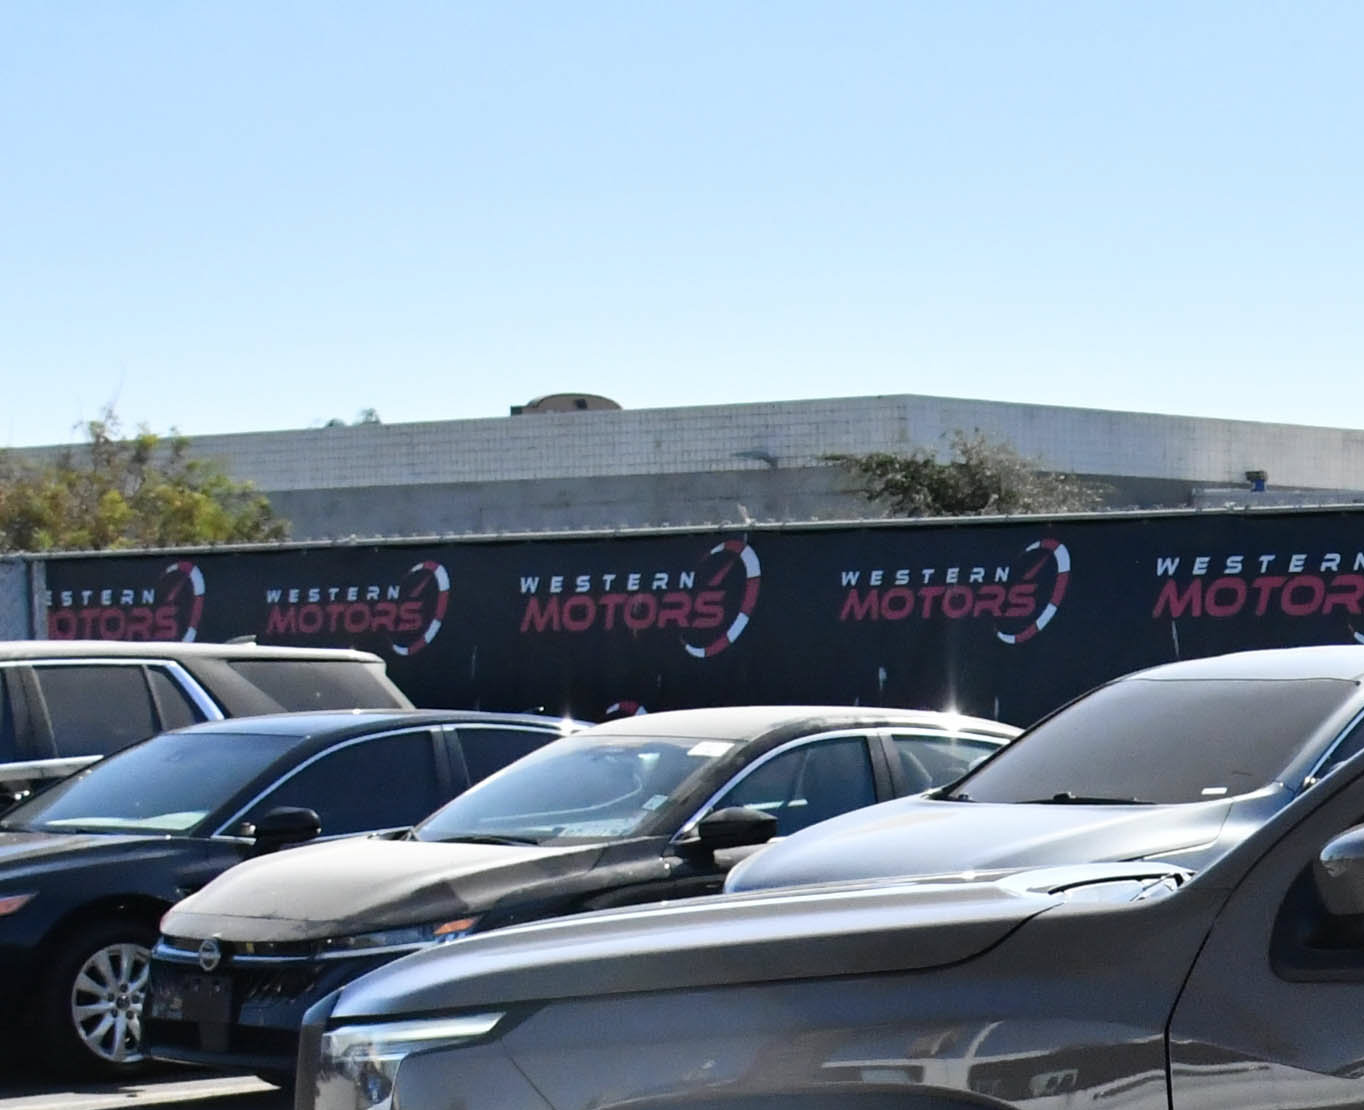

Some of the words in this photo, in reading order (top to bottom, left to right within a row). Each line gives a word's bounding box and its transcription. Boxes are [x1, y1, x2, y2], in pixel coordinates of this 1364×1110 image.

[520, 571, 696, 594] WESTERN
[841, 566, 1010, 587] WESTERN
[46, 588, 156, 607] ESTERN
[267, 585, 400, 604] WESTERN
[839, 584, 1038, 622] MOTORS
[48, 605, 178, 641] OTORS
[266, 600, 424, 635] MOTORS
[520, 589, 725, 633] MOTORS
